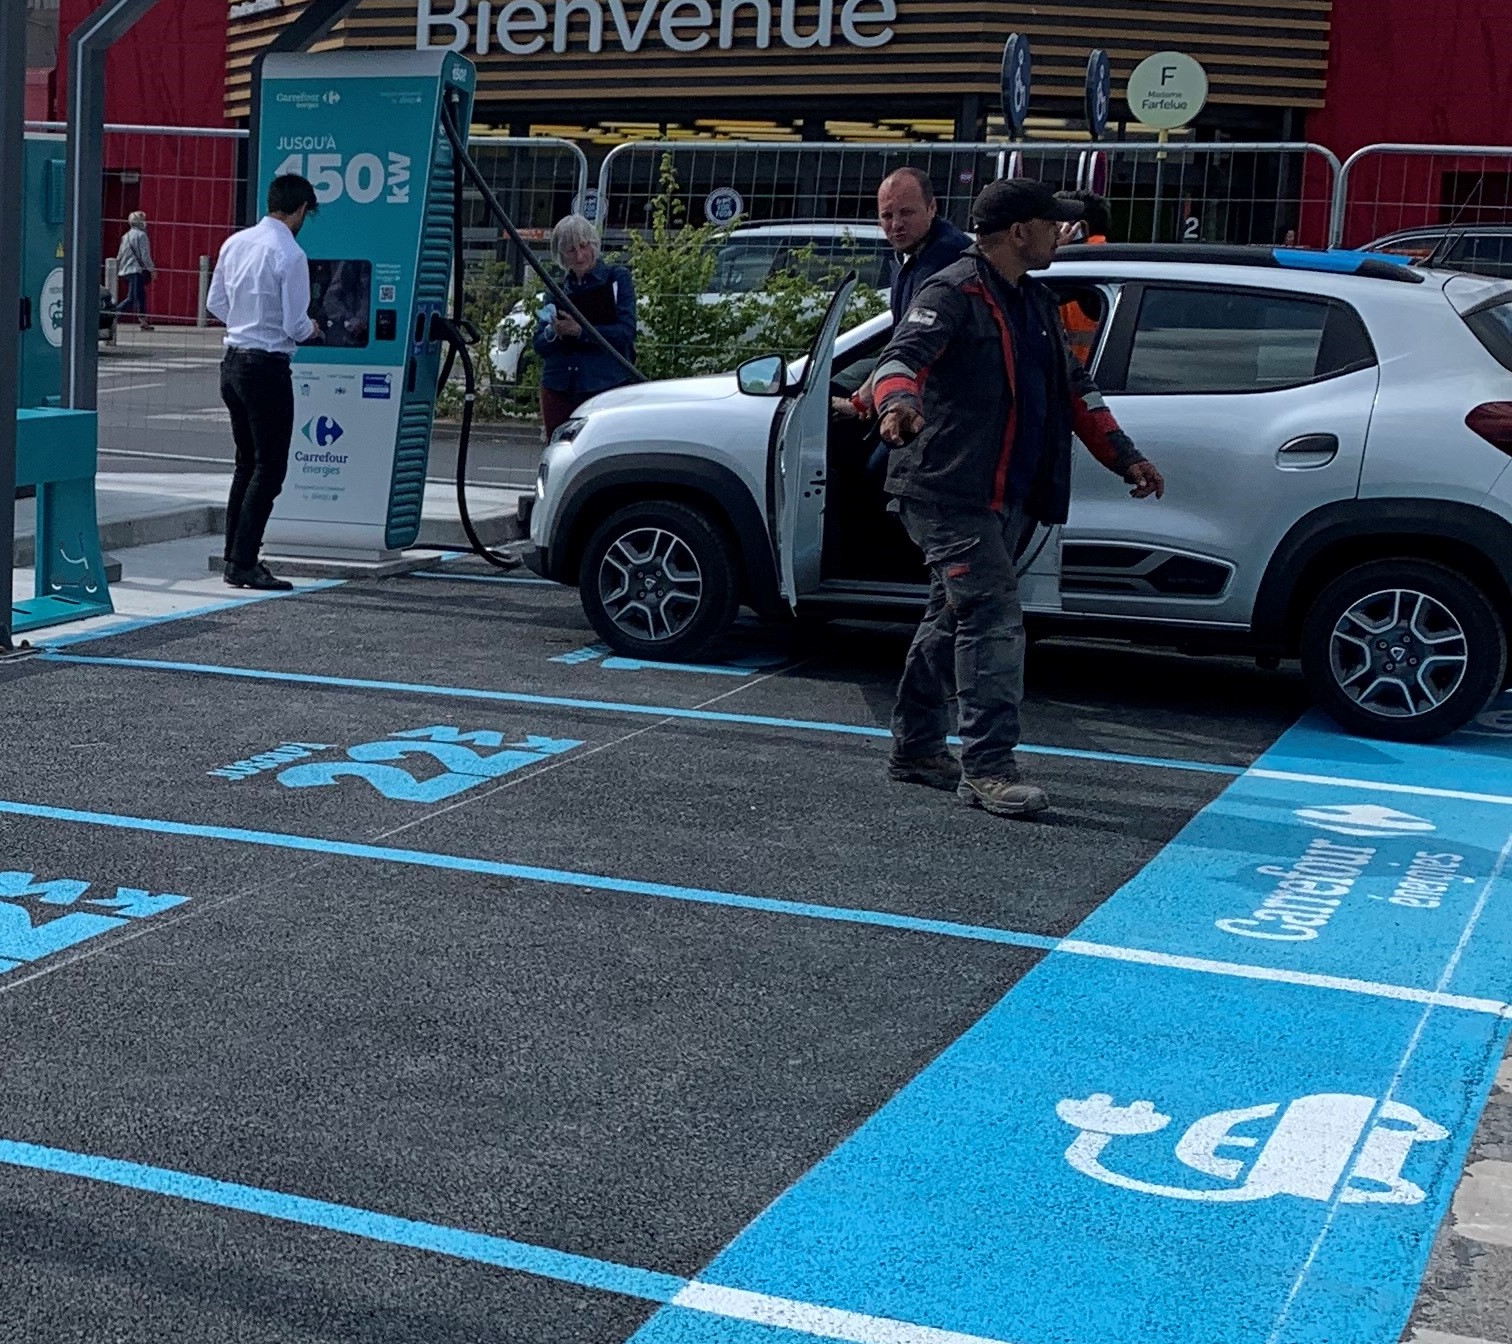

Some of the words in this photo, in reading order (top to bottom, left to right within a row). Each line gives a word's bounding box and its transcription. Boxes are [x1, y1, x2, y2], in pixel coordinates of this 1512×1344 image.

[1161, 66, 1177, 86] F
[1142, 99, 1188, 110] Farfelue
[276, 133, 336, 150] JUSQU'À
[1184, 217, 1199, 239] 2
[294, 451, 348, 463] Carrefour
[302, 463, 341, 477] énergies
[276, 740, 554, 803] 22
[1215, 839, 1376, 941] Carrefour
